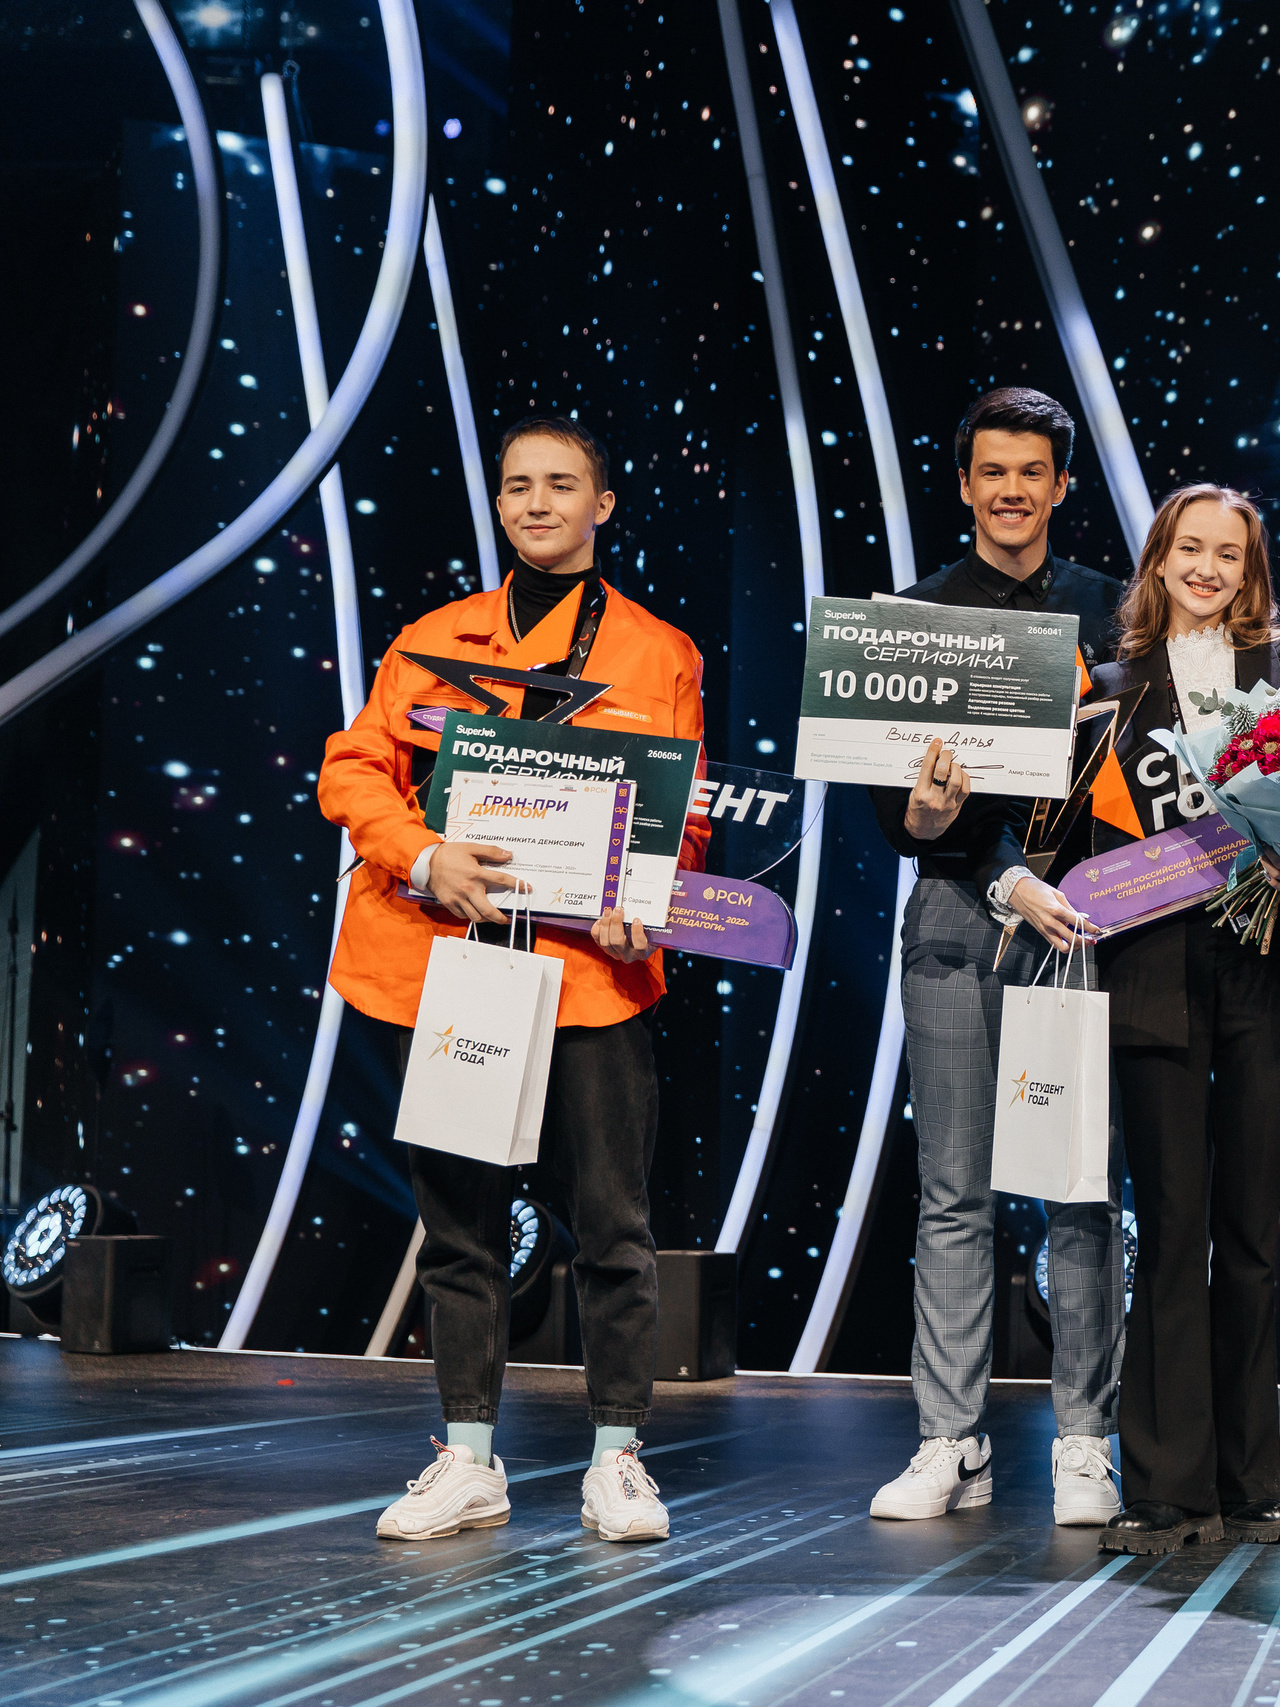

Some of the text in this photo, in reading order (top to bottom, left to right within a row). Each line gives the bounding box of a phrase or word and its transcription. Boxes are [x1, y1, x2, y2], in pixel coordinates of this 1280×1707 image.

[824, 609, 866, 620] SuperJob
[823, 625, 1005, 652] ПОДАРОЧНЫЙ
[1028, 626, 1062, 636] 2606041
[864, 646, 1019, 670] СЕРТИФИКАТ
[819, 670, 856, 698] 10
[604, 708, 647, 721] #МЫВМЕСТЕ
[456, 724, 496, 738] SuperJob
[452, 740, 625, 775] ПОДАРОЧНЫЙ
[648, 750, 682, 761] 2606054
[469, 803, 548, 820] ДИПЛОМ
[483, 795, 569, 812] ГРАН-ПРИ
[466, 833, 504, 841] КУДИШИН
[538, 839, 585, 847] ДЕНИСОВИЧ
[1089, 880, 1132, 900] ГРАН-ПРИ
[1133, 858, 1192, 884] РОССИЙСКОЙ
[1117, 850, 1238, 899] СПЕЦИАЛЬНОГО ОТКРЫТОГО
[628, 897, 652, 905] Сараков
[716, 890, 753, 907] РСМ
[696, 911, 719, 921] ГОДА
[725, 916, 750, 926] 2022»
[456, 1038, 510, 1058] СТУДЕНТ
[454, 1050, 485, 1066] ГОДА
[1029, 1082, 1064, 1095] СТУДЕНТ
[1028, 1094, 1049, 1106] ГОДА
